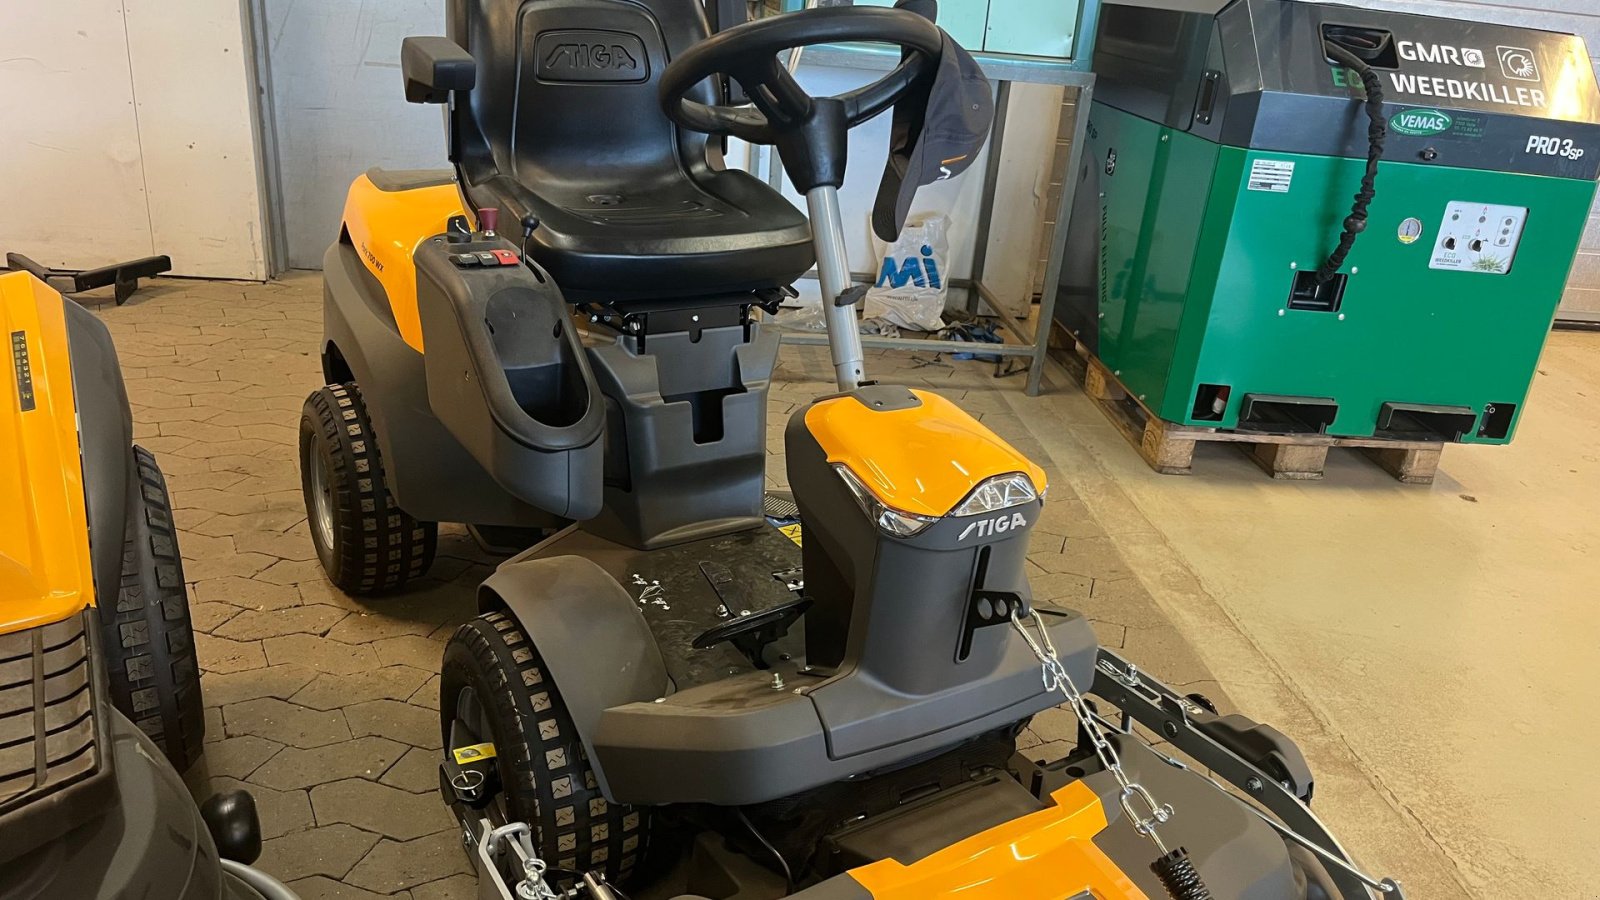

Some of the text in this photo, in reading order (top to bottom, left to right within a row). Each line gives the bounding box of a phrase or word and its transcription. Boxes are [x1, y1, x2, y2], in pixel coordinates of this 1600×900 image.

[545, 43, 636, 70] STIGA
[1398, 41, 1462, 66] GMR
[1389, 72, 1547, 109] WEEDKILLER
[1525, 135, 1560, 156] PRO
[957, 512, 1027, 541] STIGA
